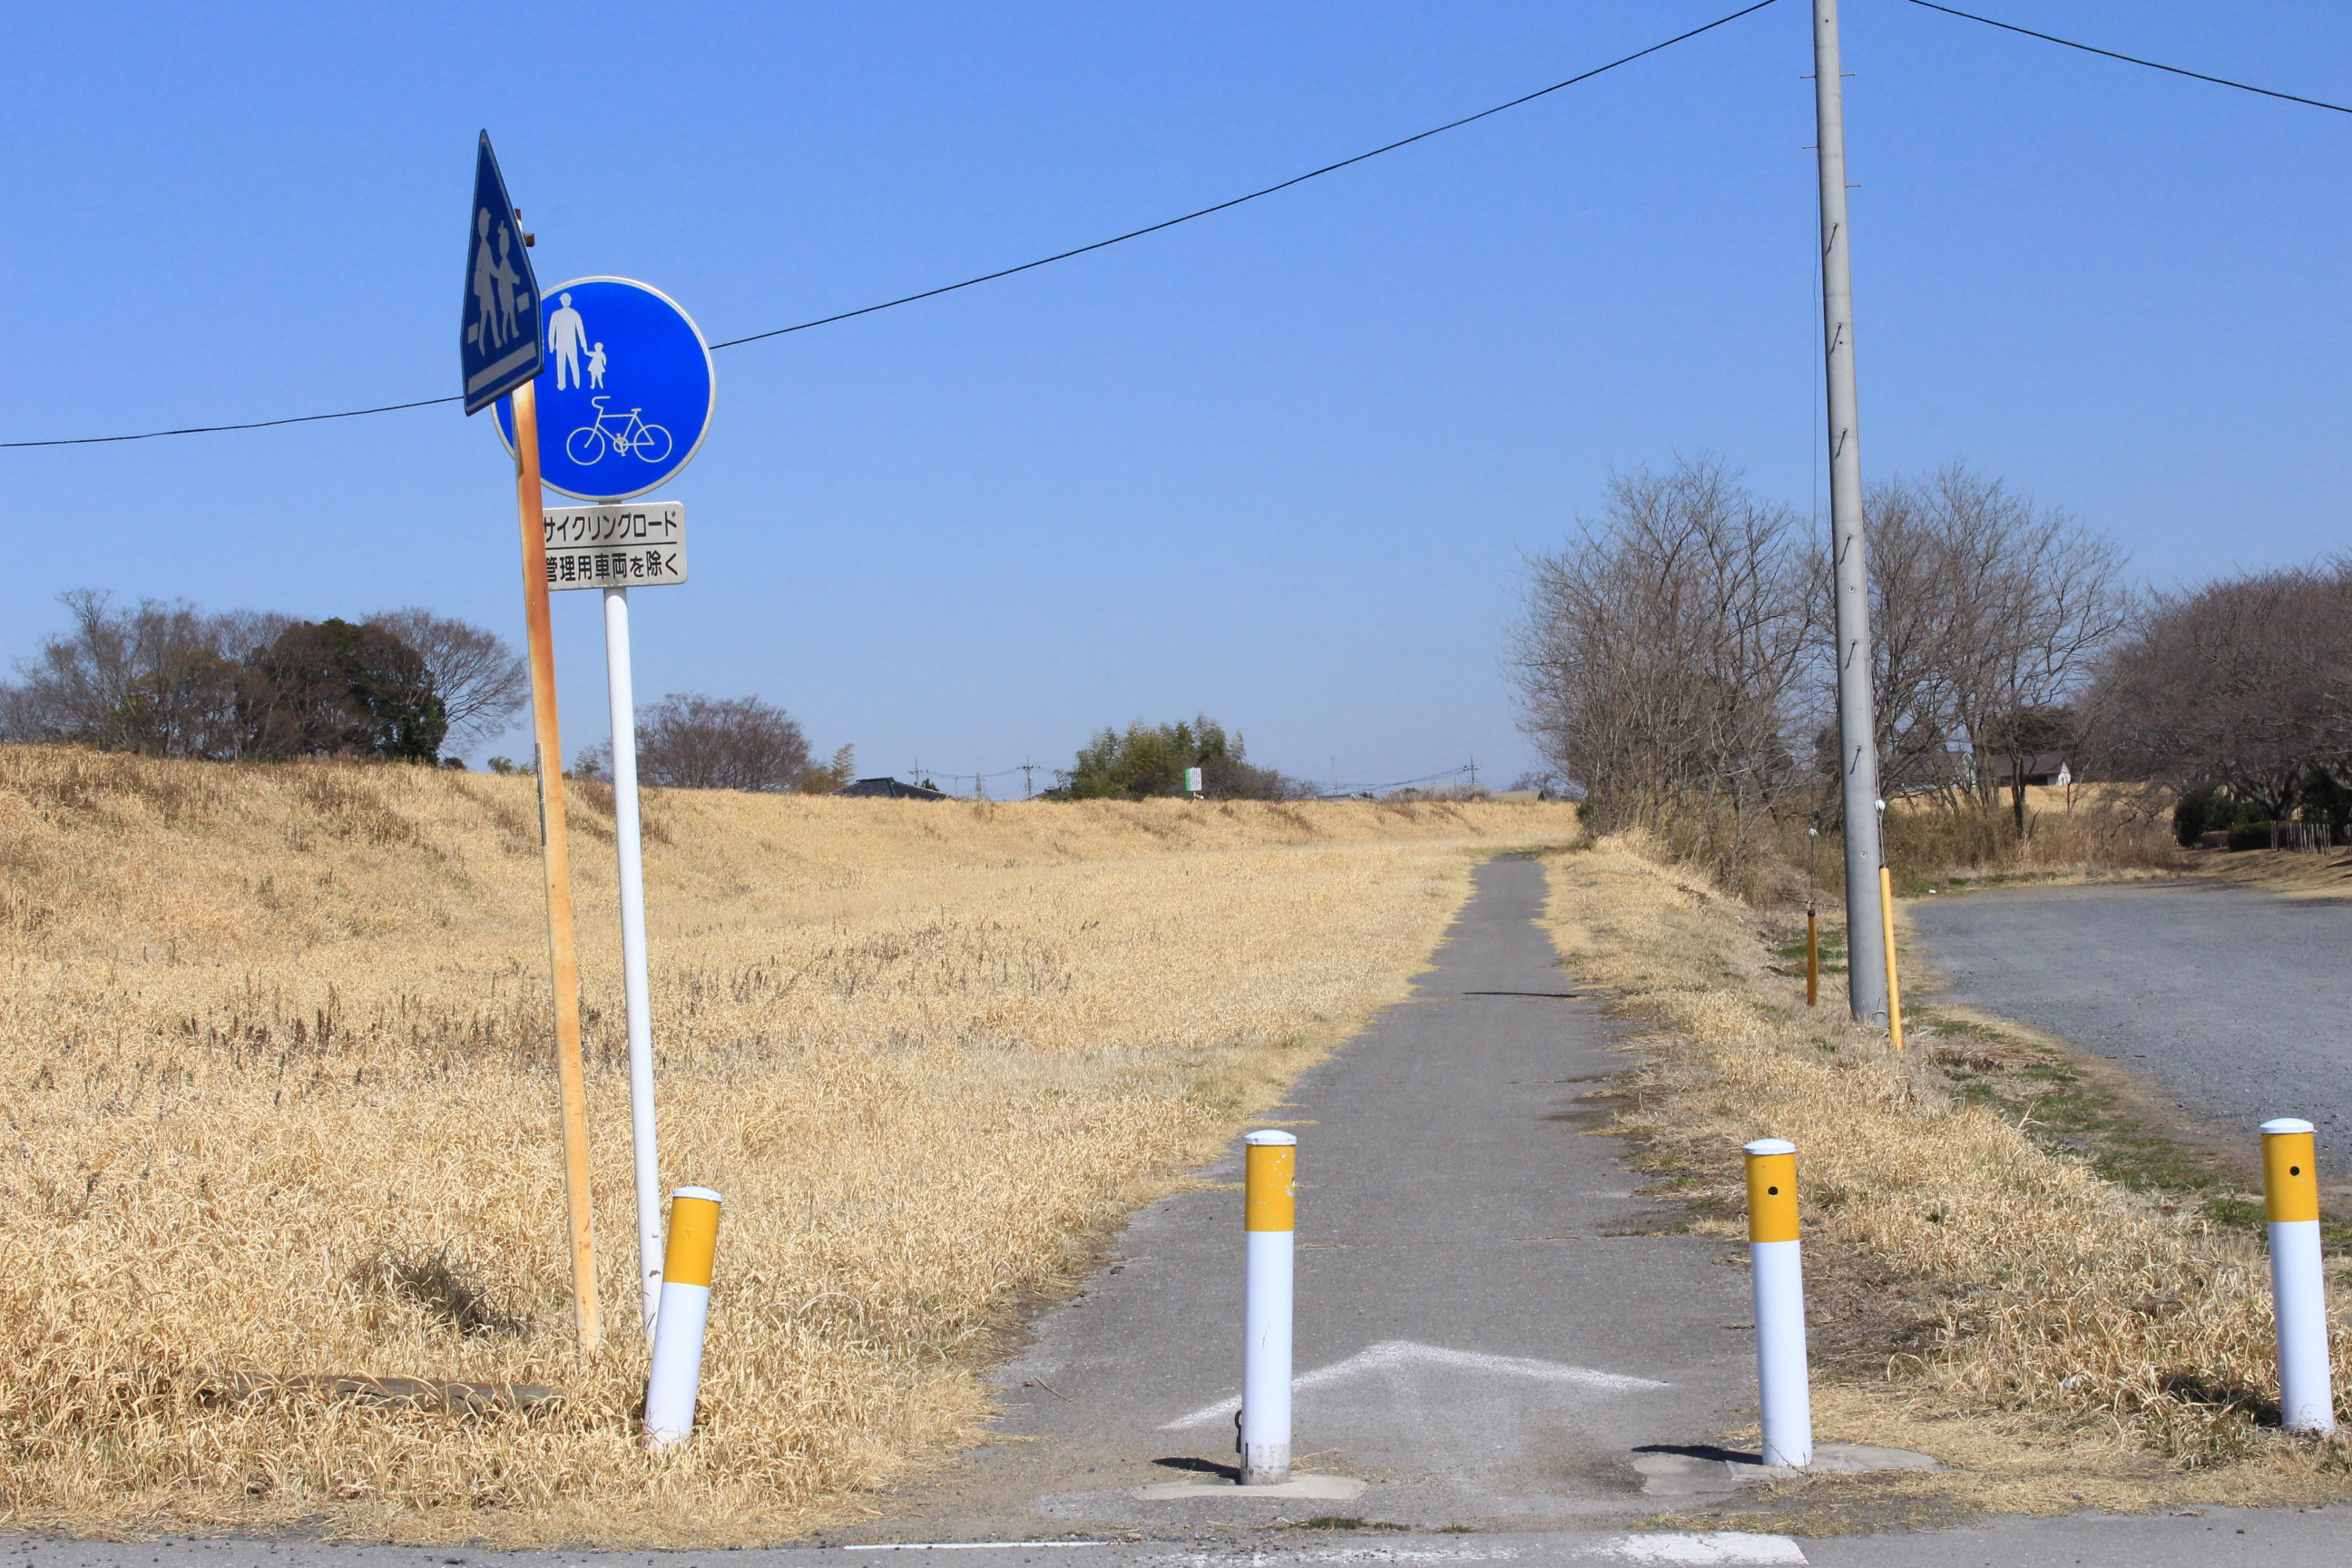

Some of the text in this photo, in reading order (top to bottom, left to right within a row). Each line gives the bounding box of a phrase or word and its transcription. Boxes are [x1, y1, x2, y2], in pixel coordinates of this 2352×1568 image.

[544, 510, 677, 543] サイクリングロード
[545, 550, 679, 583] 管理用車両を除く
